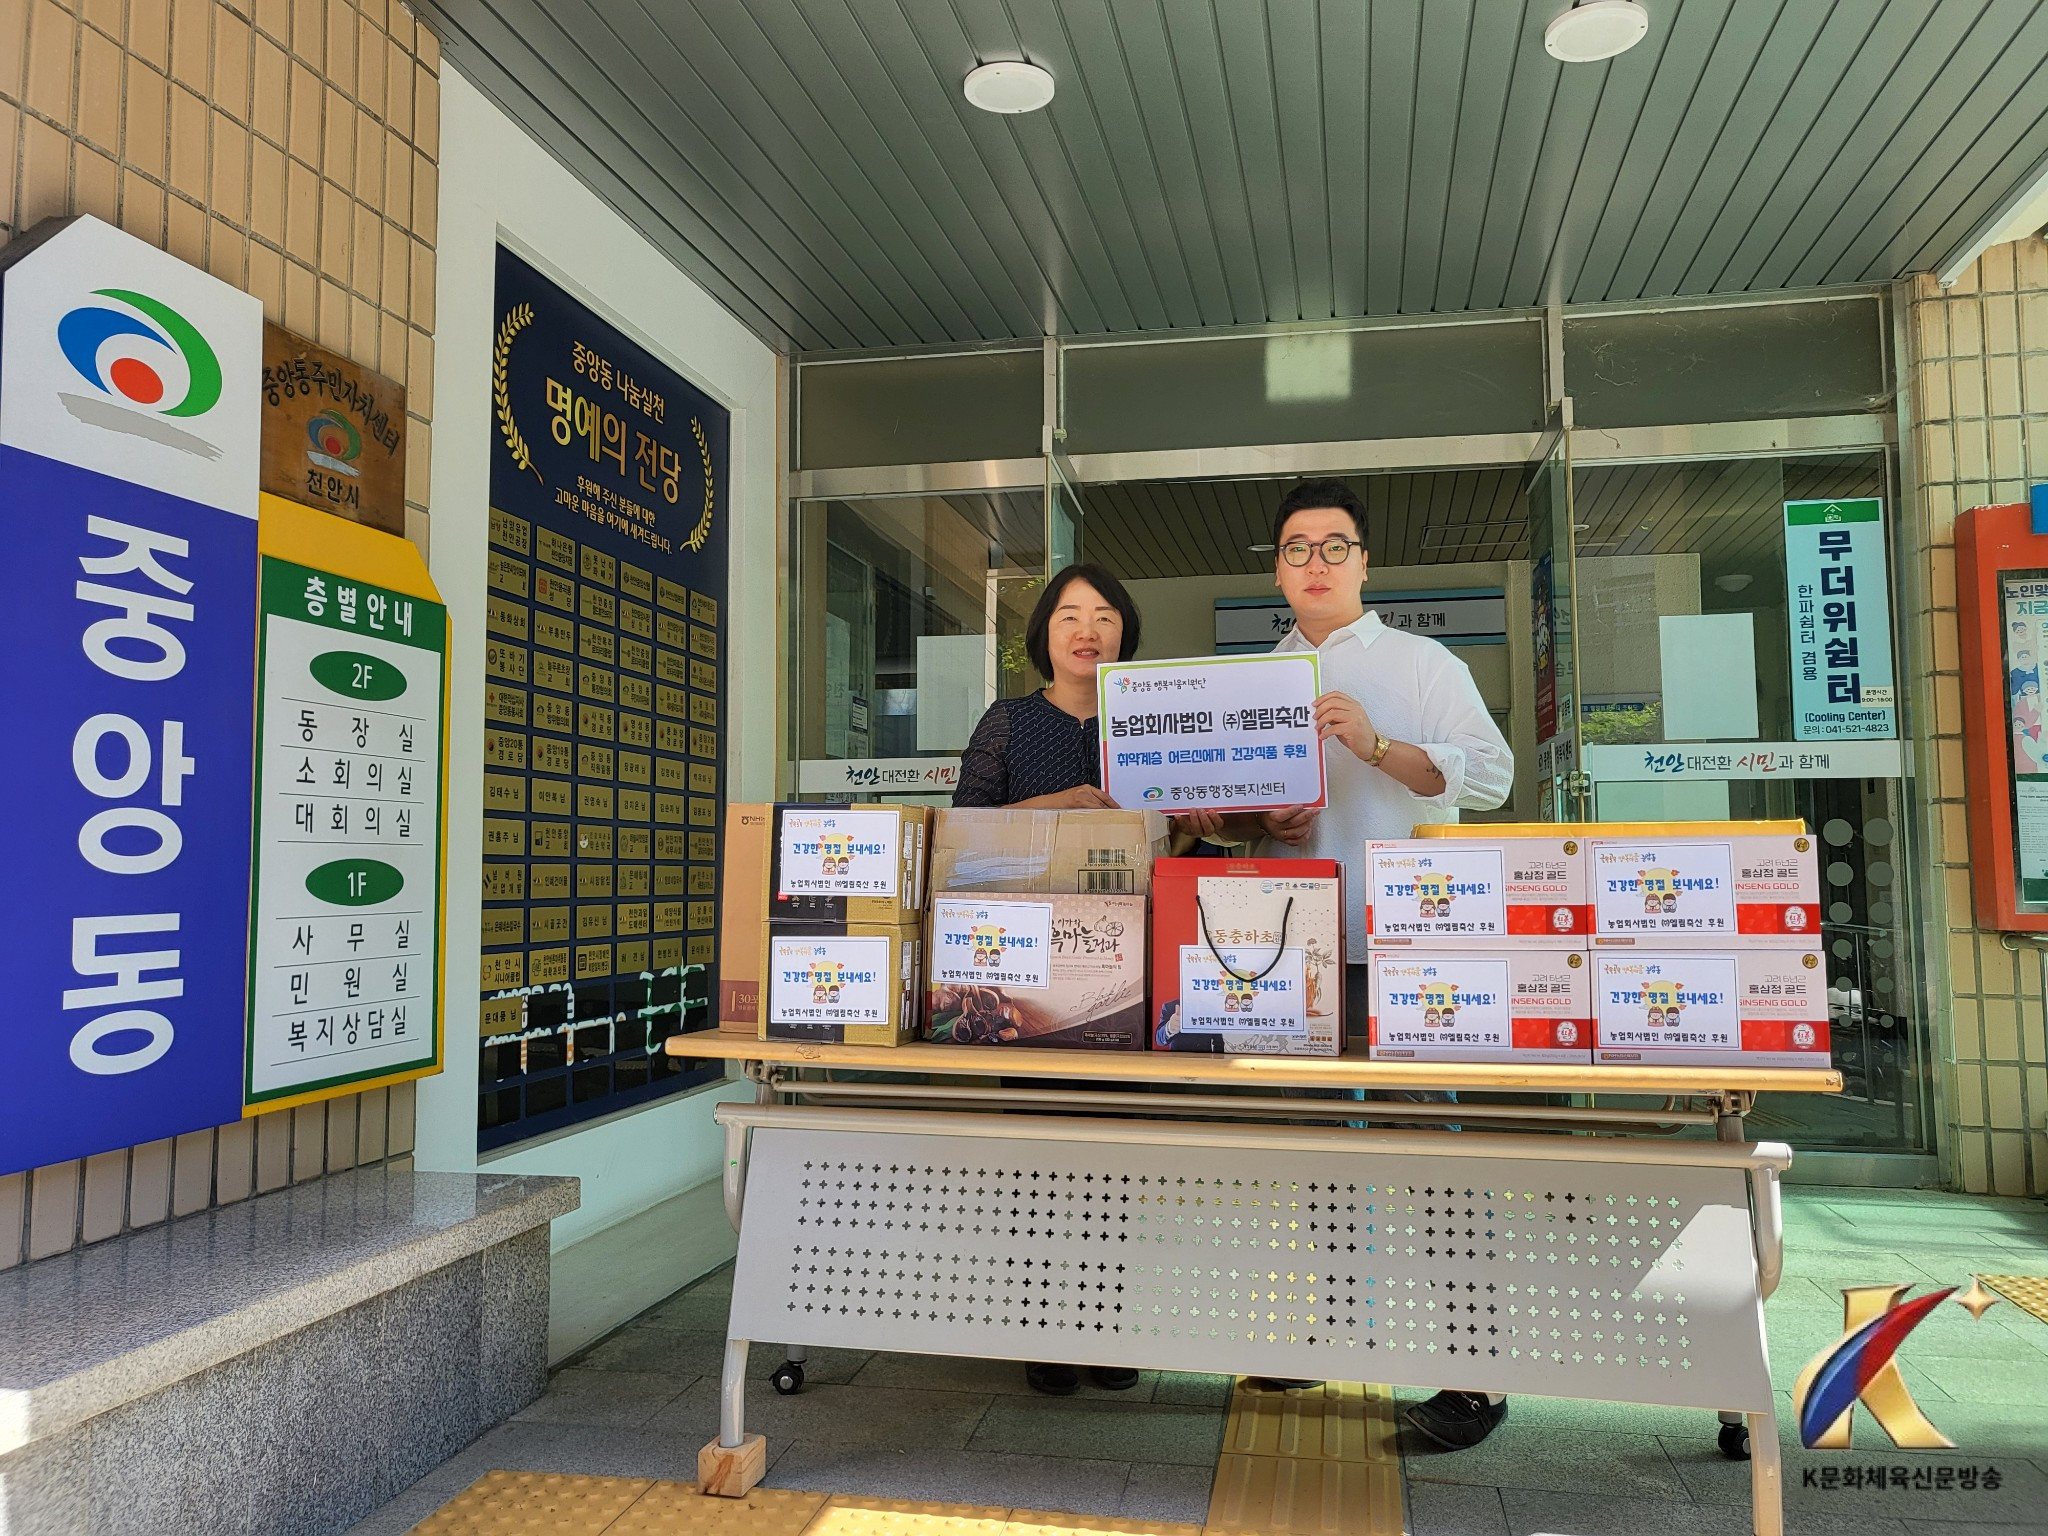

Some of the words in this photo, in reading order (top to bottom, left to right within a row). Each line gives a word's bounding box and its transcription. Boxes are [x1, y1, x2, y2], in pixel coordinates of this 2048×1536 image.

[572, 341, 613, 391] 중앙동
[616, 369, 664, 424] 나눔실천
[546, 377, 627, 476] 명예의
[635, 431, 682, 504] 전당
[306, 469, 360, 509] 천안시
[602, 488, 617, 507] 주신
[619, 495, 641, 520] 분들에
[642, 503, 656, 527] 대한
[555, 487, 580, 513] 고마운
[581, 498, 605, 525] 마음을
[606, 506, 629, 534] 여기에
[630, 516, 673, 555] 새겨드립니다.
[304, 576, 412, 637] 층별안내
[1417, 612, 1446, 628] 함께
[1798, 585, 1816, 644] 한파쉼터
[1818, 530, 1861, 704] 무더위쉼터
[1802, 651, 1818, 681] 겸용
[351, 663, 372, 689] 2F
[1131, 680, 1151, 692] 중앙동
[1154, 677, 1207, 691] 행복키움지원단
[1111, 711, 1213, 738] 농업회사법인
[1117, 751, 1163, 767] 취약계층
[1168, 748, 1226, 764] 어르신에게
[1231, 746, 1278, 761] 건강식품
[1283, 744, 1307, 759] 후원
[1687, 755, 1732, 771] 대전환
[1799, 754, 1830, 770] 함께
[883, 769, 921, 783] 대전환
[63, 515, 195, 1075] 중앙동
[489, 786, 510, 798] 김태수
[1170, 781, 1286, 800] 중앙동행정복지센터
[792, 843, 819, 855] 건강한
[824, 843, 841, 855] 명절
[847, 843, 886, 855] 보내세요!
[1514, 870, 1544, 881] 홍삼정
[1547, 870, 1567, 880] 골드
[1741, 868, 1774, 878] 홍삼정
[1777, 868, 1799, 878] 골드
[347, 872, 367, 897] 1F
[790, 880, 831, 889] 농업회사법인
[873, 880, 887, 889] 후원
[1384, 884, 1414, 896] 건강한
[1420, 884, 1440, 896] 명절
[1446, 883, 1491, 895] 보내세요!
[1607, 879, 1638, 892] 건강한
[1645, 879, 1665, 891] 명절
[1672, 877, 1720, 890] 보내세요!
[1384, 923, 1431, 932] 농업회사법인
[1479, 922, 1495, 932] 후원
[1608, 919, 1656, 928] 농업회사법인
[1708, 918, 1724, 928] 후원
[944, 933, 970, 946] 건강한
[976, 934, 993, 946] 명절
[998, 935, 1038, 948] 보내세요!
[1214, 929, 1274, 944] 동충하초
[494, 957, 521, 970] 천안시
[494, 970, 521, 984] 시니어클럽
[783, 971, 809, 983] 건강한
[814, 971, 831, 983] 명절
[837, 971, 876, 983] 보내세요!
[941, 969, 982, 980] 농업회사법인
[1025, 974, 1039, 983] 후원
[1192, 979, 1219, 991] 건강한
[1226, 979, 1244, 991] 명절
[1250, 979, 1292, 992] 보내세요!
[1517, 983, 1548, 993] 홍삼정
[1550, 983, 1571, 993] 골드
[1749, 984, 1781, 994] 홍삼정
[1785, 984, 1806, 994] 골드
[1389, 993, 1419, 1005] 건강한
[1425, 993, 1445, 1005] 명절
[1451, 993, 1496, 1005] 보내세요!
[1610, 992, 1641, 1004] 건강한
[1648, 992, 1669, 1004] 명절
[1676, 992, 1724, 1005] 보내세요!
[781, 1008, 822, 1018] 농업회사법인
[864, 1008, 878, 1018] 후원
[288, 1005, 406, 1052] 복지상담실
[1191, 1017, 1234, 1027] 농업회사법인
[1280, 1018, 1295, 1027] 후원
[1389, 1032, 1435, 1042] 농업회사법인
[1484, 1033, 1500, 1043] 후원
[1610, 1031, 1659, 1042] 농업회사법인
[1711, 1033, 1728, 1043] 후원
